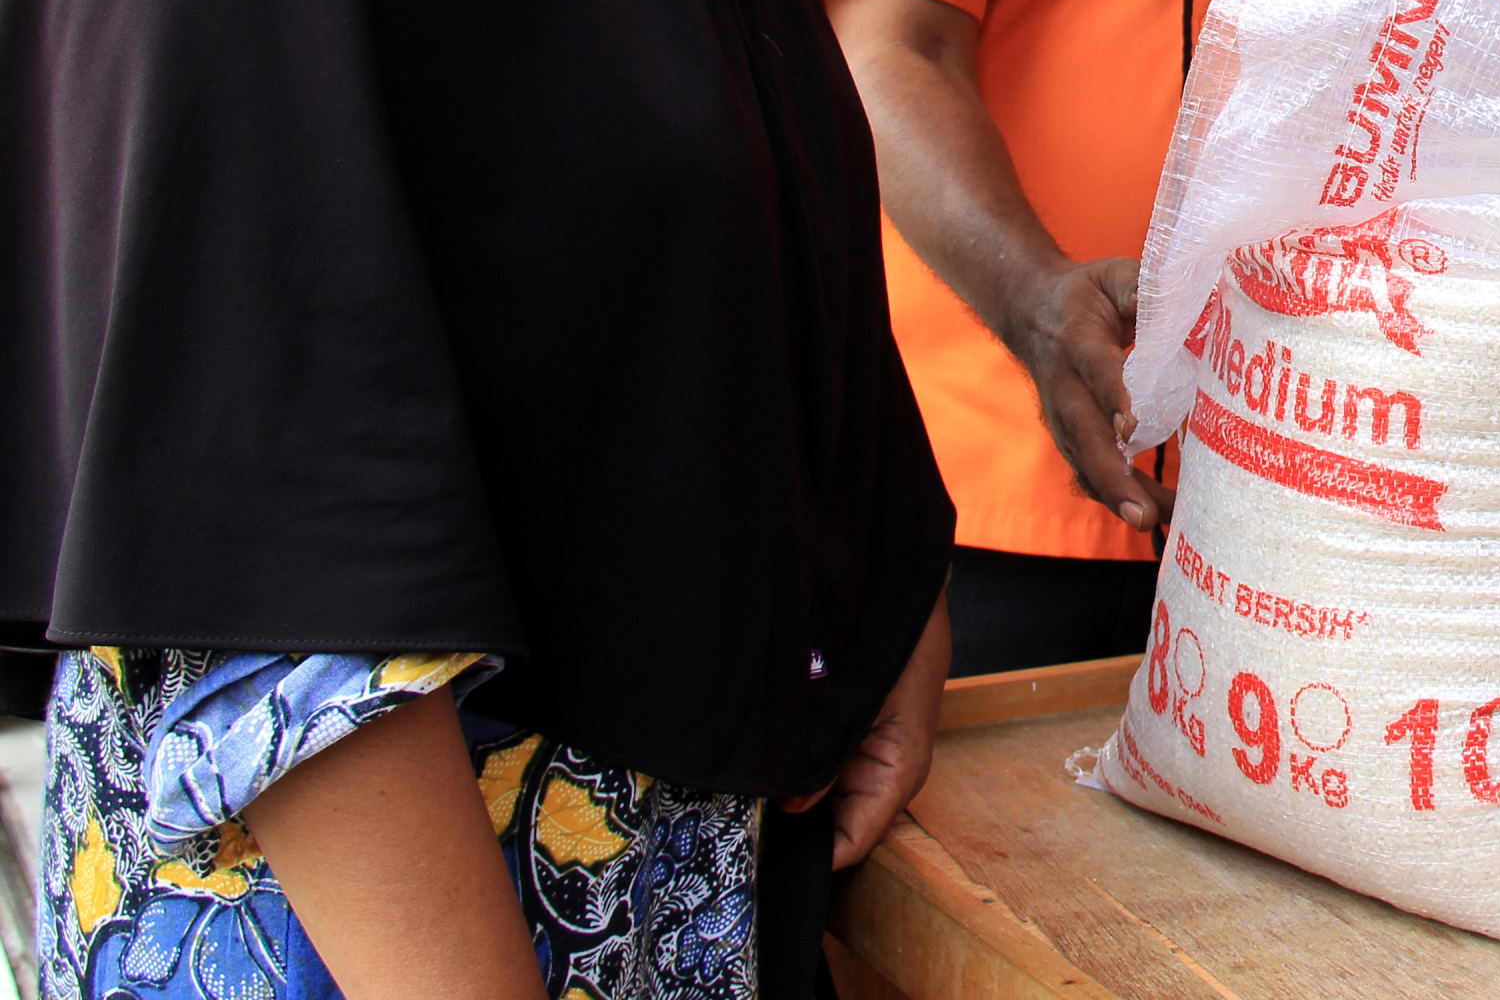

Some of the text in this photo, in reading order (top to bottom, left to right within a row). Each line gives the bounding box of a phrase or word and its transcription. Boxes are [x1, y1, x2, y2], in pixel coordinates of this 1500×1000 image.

[1208, 292, 1422, 451] Medium
[1175, 535, 1231, 606] BERAT
[1148, 600, 1170, 716] 8
[1228, 671, 1349, 808] 9 Kg
